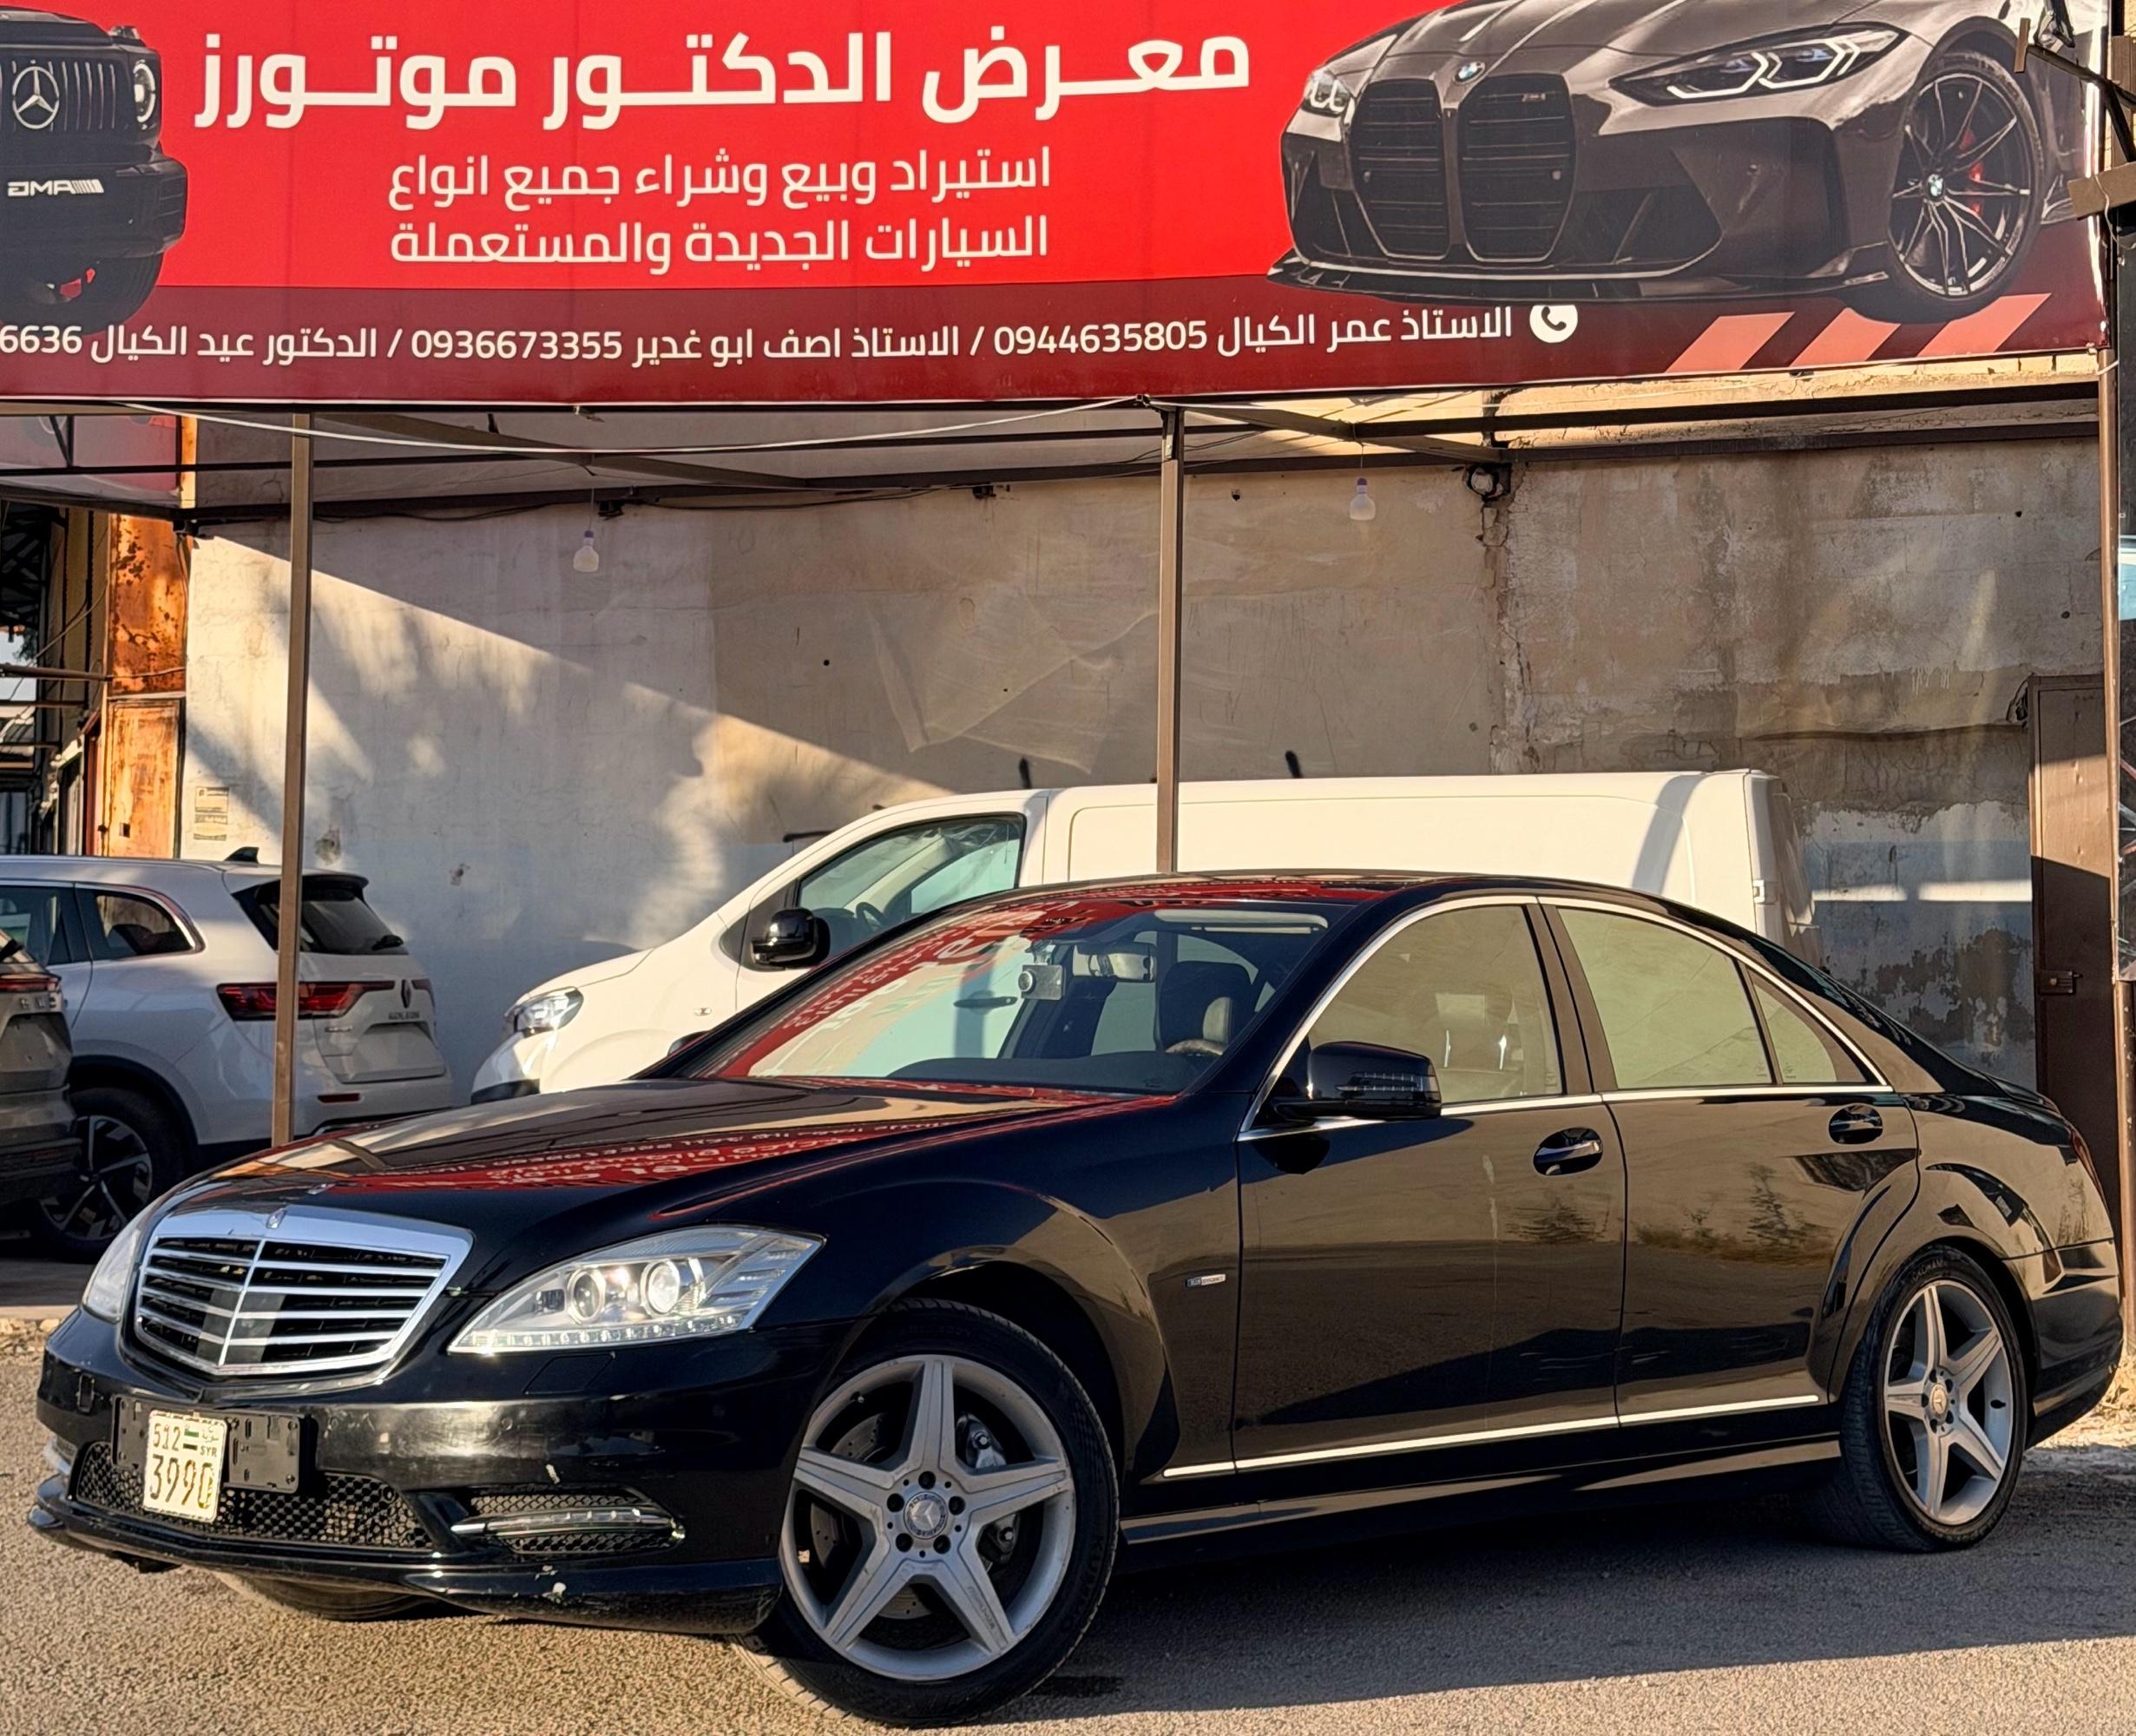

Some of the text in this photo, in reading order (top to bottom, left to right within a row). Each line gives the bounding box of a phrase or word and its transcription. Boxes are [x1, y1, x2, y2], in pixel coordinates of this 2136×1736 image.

[194, 26, 1250, 130] معرض الدكتور موتورز
[388, 146, 1049, 212] استيراد وبيع وشراء جميع انواع
[391, 214, 1047, 275] السيارات الجديدة والمستعملة
[994, 320, 1207, 355] 0944635805
[1217, 313, 1315, 357] الكيال
[1326, 319, 1392, 353] عمر
[1400, 306, 1512, 340] الاستاذ
[90, 324, 187, 364] الكيال
[197, 333, 254, 363] عيد
[262, 327, 377, 366] الدكتور
[411, 330, 622, 359] 0936673355
[631, 329, 702, 368] غدير
[710, 328, 753, 368] ابو
[763, 328, 840, 358] اصف
[850, 326, 959, 358] الاستاذ
[153, 1422, 181, 1451] 512
[200, 1445, 218, 1457] SYR
